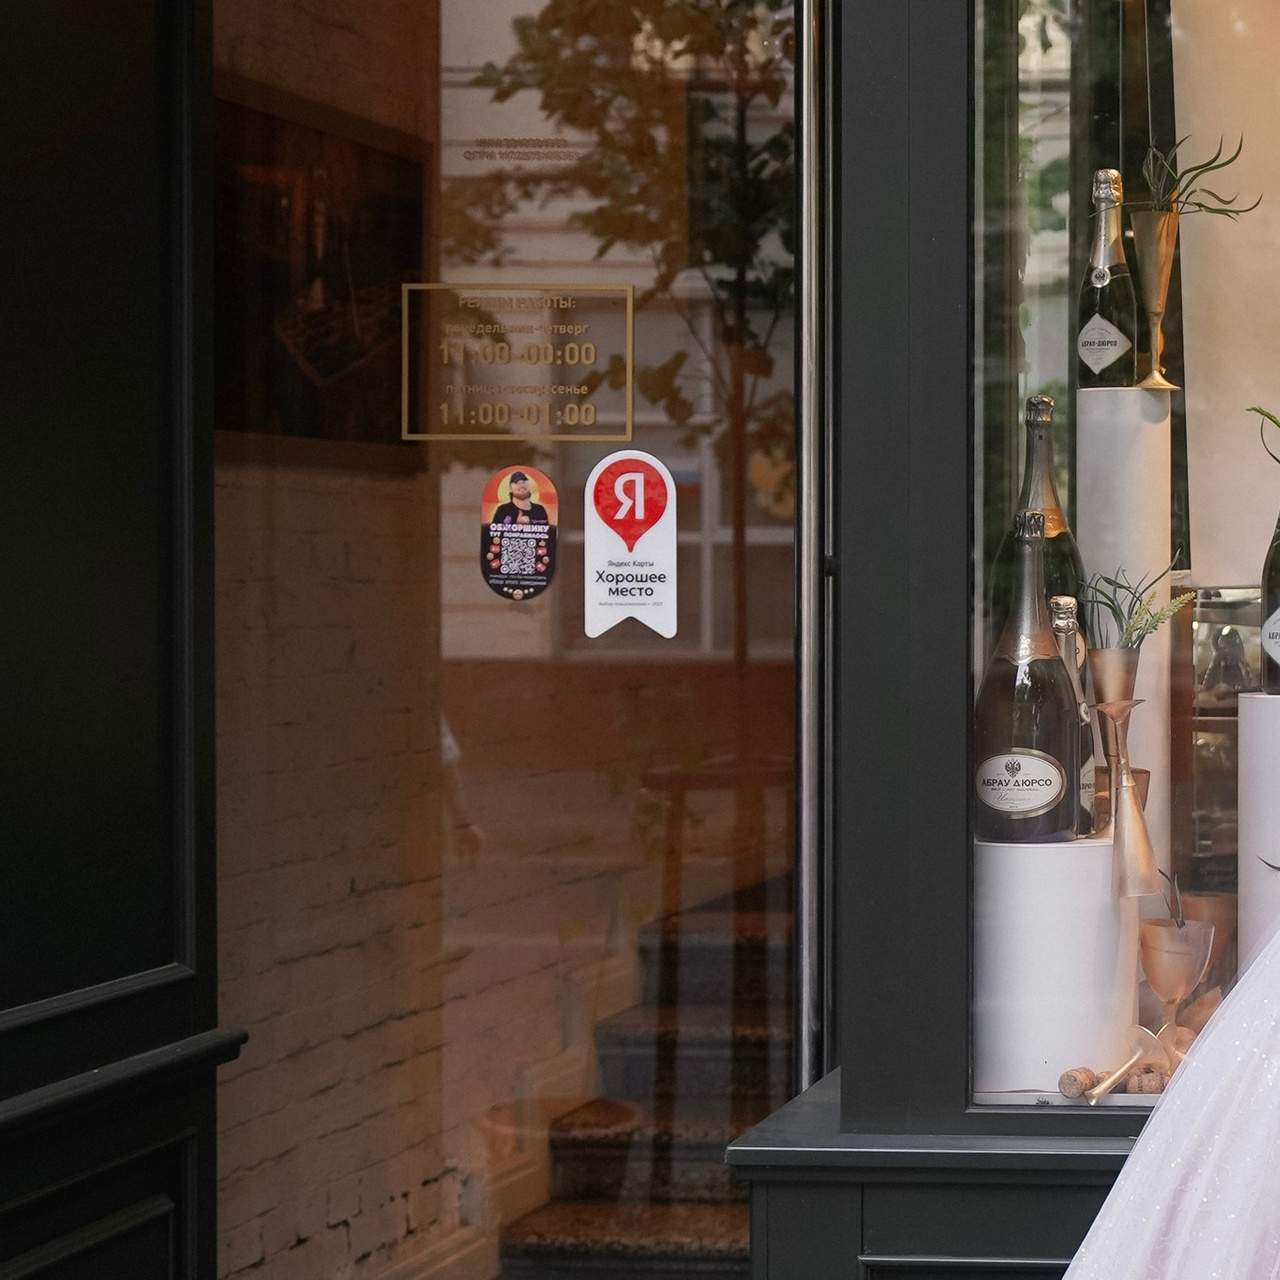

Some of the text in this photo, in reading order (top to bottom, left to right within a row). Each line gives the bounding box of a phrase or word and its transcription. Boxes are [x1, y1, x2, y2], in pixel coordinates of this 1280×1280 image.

[613, 472, 645, 520] Я
[632, 560, 654, 568] Карты
[595, 570, 667, 586] Хорошее
[608, 587, 654, 597] место
[982, 778, 1053, 787] АБРАУ ДЮРСО
